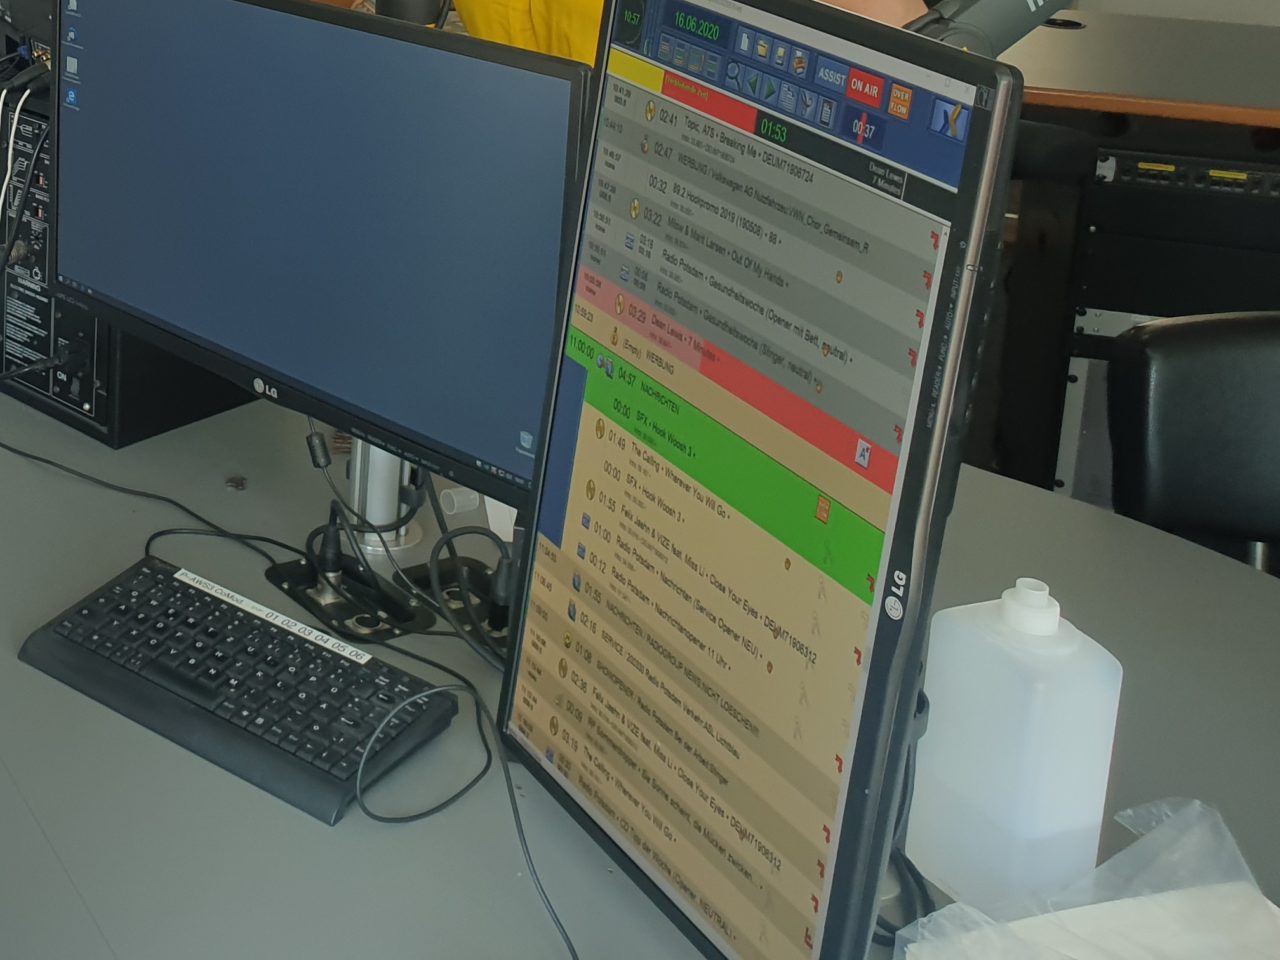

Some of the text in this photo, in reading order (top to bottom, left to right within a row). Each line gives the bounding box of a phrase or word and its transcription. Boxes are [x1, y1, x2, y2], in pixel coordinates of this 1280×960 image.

[675, 11, 719, 41] 16.06.2020
[818, 67, 846, 87] ASSIST
[851, 78, 879, 98] ON AIR
[893, 89, 909, 100] OVER
[658, 107, 678, 128] 02:41
[890, 102, 908, 114] FLOW
[683, 115, 700, 134] Topic,
[719, 131, 746, 155] Breaking
[746, 143, 757, 158] Me
[760, 118, 787, 142] 01:53
[852, 119, 875, 139] 00:37
[653, 140, 673, 161] 02:47
[677, 152, 707, 176] WERBUNG
[648, 173, 667, 194] 00:32
[672, 182, 684, 198] 89.2
[719, 206, 735, 224] 2019
[642, 206, 662, 228] 03:22
[661, 248, 678, 266] Radio
[678, 257, 704, 281] Potsdam
[730, 249, 742, 265] Out
[752, 261, 762, 278] My
[763, 267, 784, 288] Hands
[656, 280, 672, 299] Radio
[673, 290, 698, 315] Potsdam
[569, 334, 594, 361] 11:00:00
[645, 348, 674, 376] WERBUNG
[617, 366, 635, 388] 04:57
[265, 384, 278, 399] LG
[640, 380, 679, 416] NACHRICHTEN
[612, 397, 630, 420] 00:00
[608, 428, 625, 451] 01:49
[636, 410, 686, 454] SFX Hook Woosh
[603, 459, 621, 483] 00:00
[630, 441, 726, 519] The Calling Wherever You Will Go
[598, 489, 616, 513] 01:55
[626, 473, 637, 490] SFX
[642, 485, 656, 504] Hook
[656, 496, 675, 519] Woosh
[593, 520, 611, 544] 01:00
[589, 551, 606, 575] 00:12
[620, 503, 633, 522] Felix
[634, 514, 650, 535] Jaehn
[656, 531, 670, 551] VIZE
[684, 552, 698, 572] Miss
[709, 572, 726, 594] Close
[726, 586, 742, 607] Your
[742, 598, 758, 622] Eyes
[891, 570, 907, 597] LG
[615, 534, 631, 555] Radio
[631, 547, 655, 574] Potsdam
[660, 570, 692, 604] Nachrichten
[692, 596, 717, 627] (Service
[717, 616, 740, 645] Opener
[740, 635, 758, 660] NEU)
[611, 565, 626, 586] Radio
[626, 578, 650, 606] Potsdam
[715, 652, 727, 671] Uhr
[264, 611, 365, 661] 01 02 03 04 05 06
